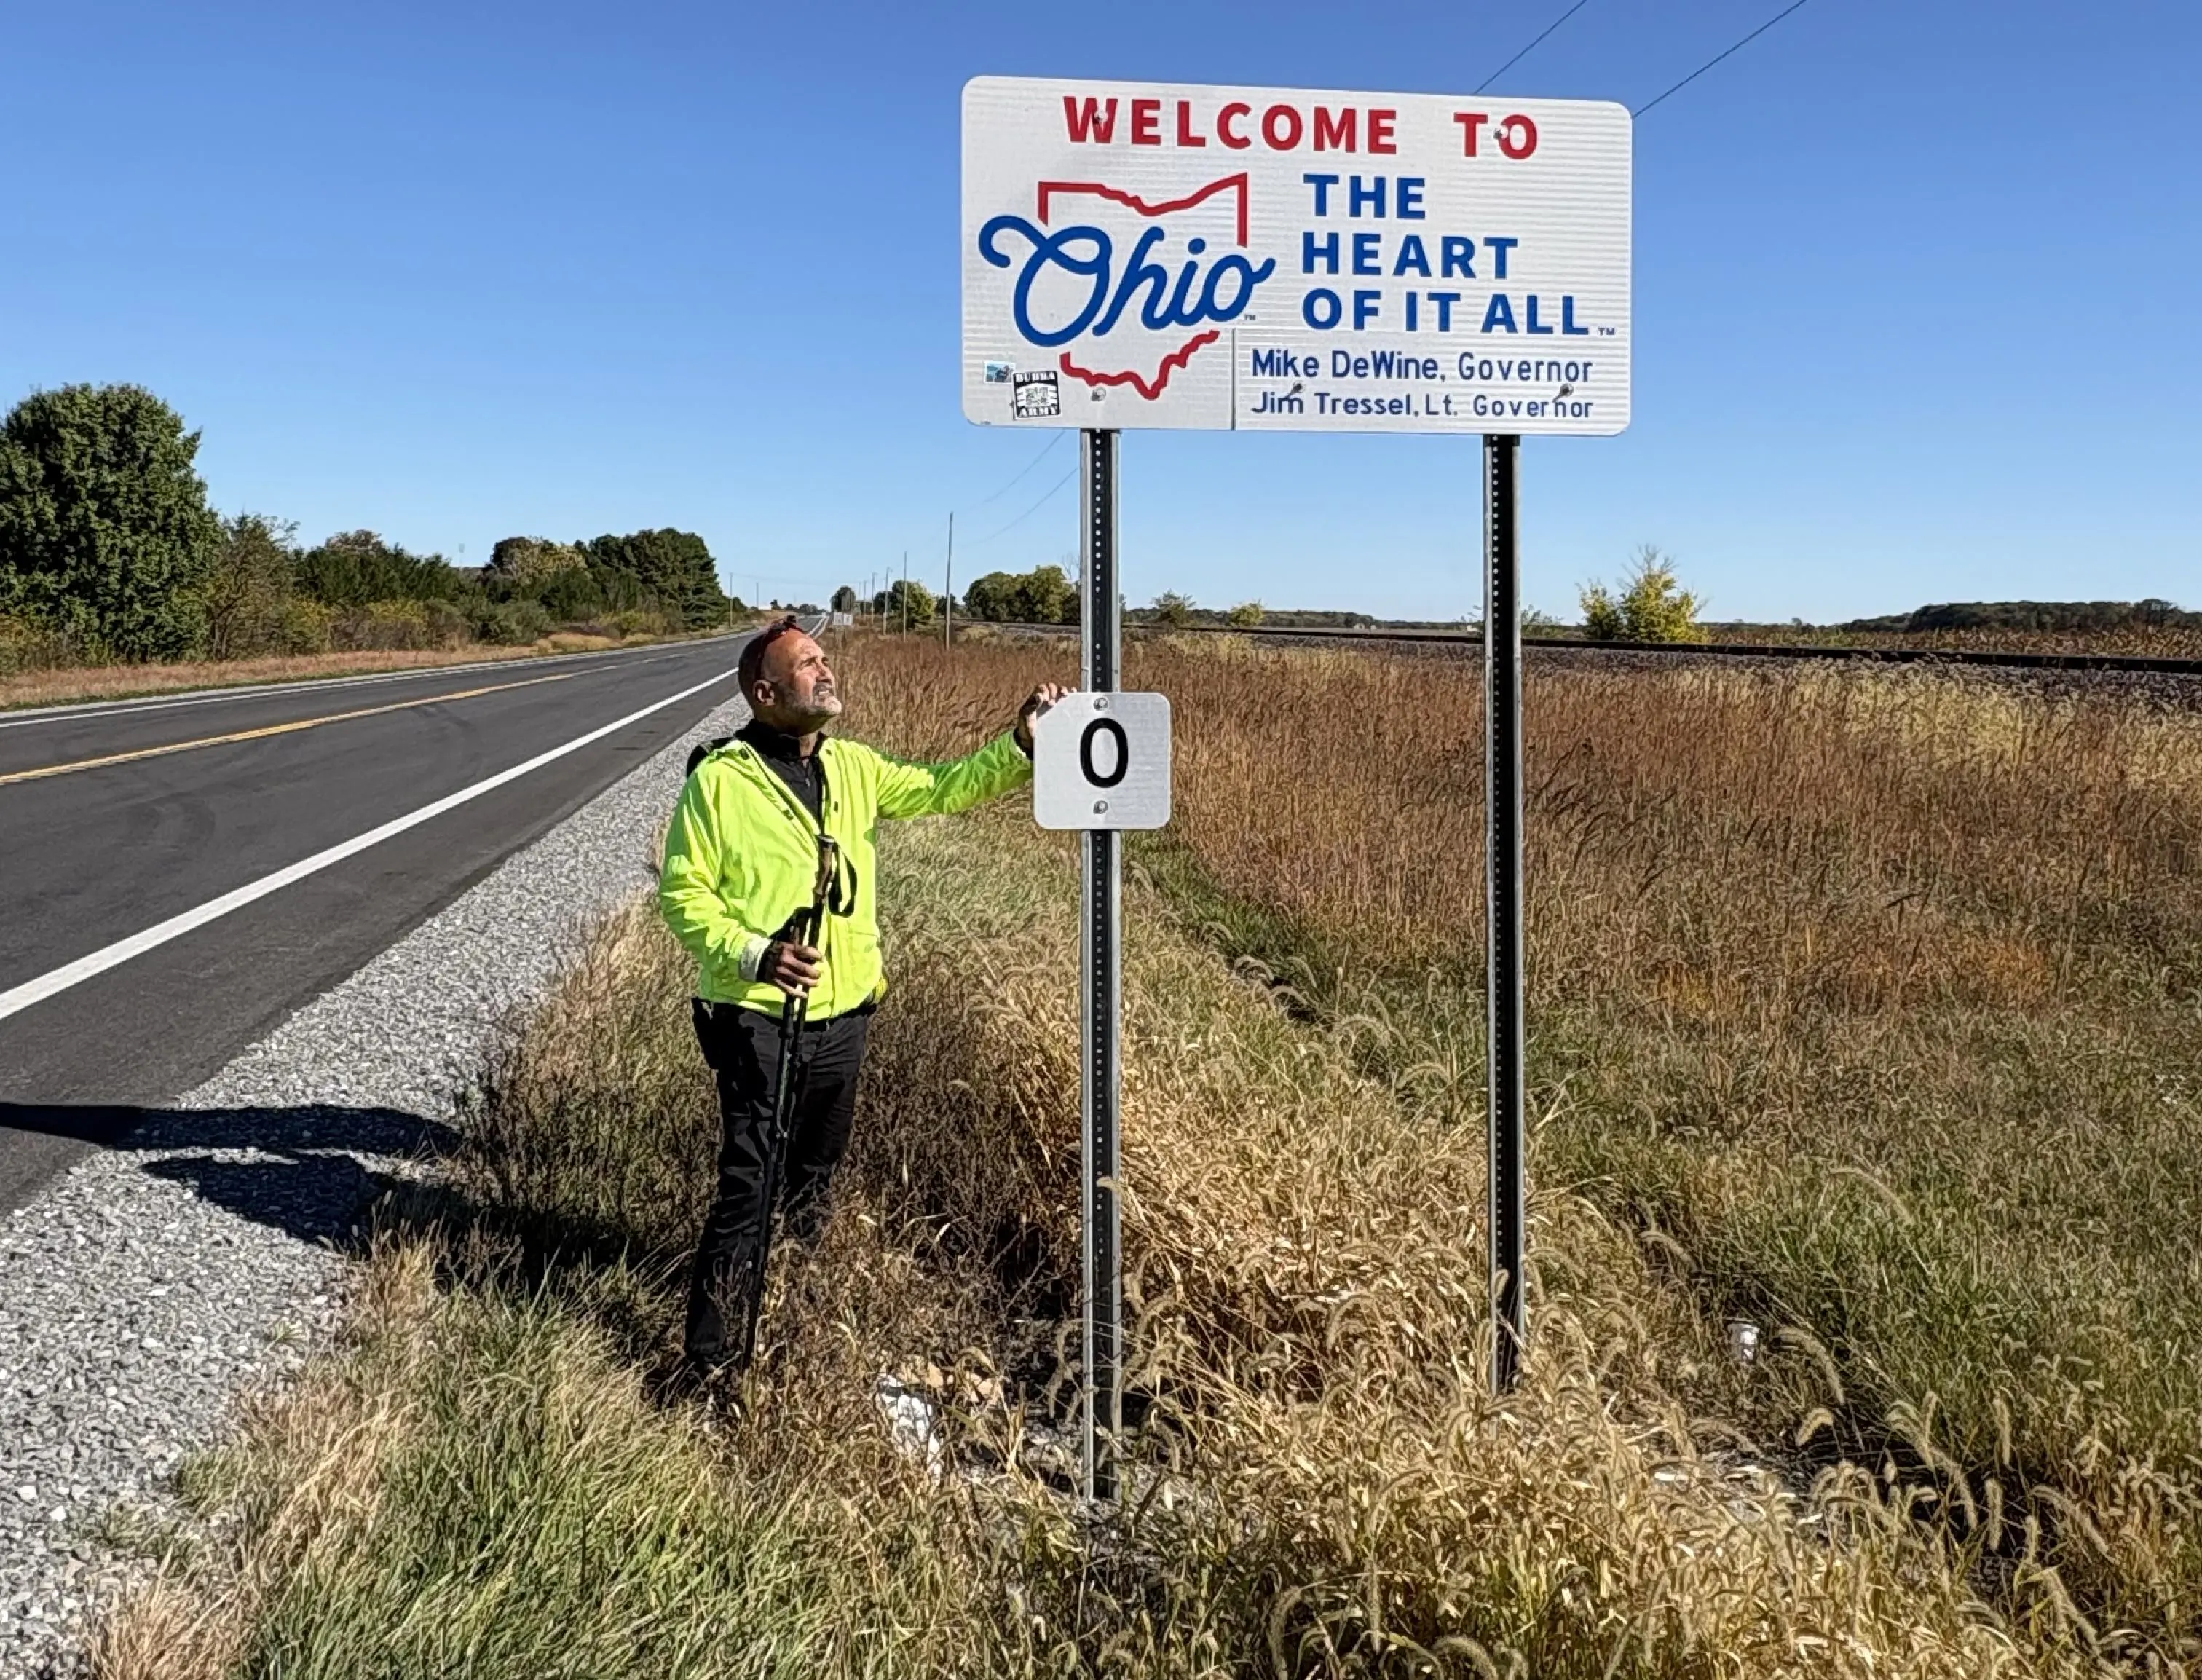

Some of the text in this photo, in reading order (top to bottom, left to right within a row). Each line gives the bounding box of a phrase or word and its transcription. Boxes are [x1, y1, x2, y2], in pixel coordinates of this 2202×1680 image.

[1064, 96, 1539, 159] WELCOME TO
[1303, 173, 1426, 220] THE
[1301, 230, 1519, 280] HEART
[979, 214, 1276, 347] Ohio
[1301, 287, 1382, 331] OF
[1405, 291, 1461, 333] IT
[1482, 293, 1589, 336] ALL
[1015, 371, 1055, 382] BUBBA
[1252, 347, 1593, 383] Mike DeWine, Governor
[1019, 406, 1057, 417] ARMY
[1250, 390, 1594, 418] Jim Tressel, Lt. Governor
